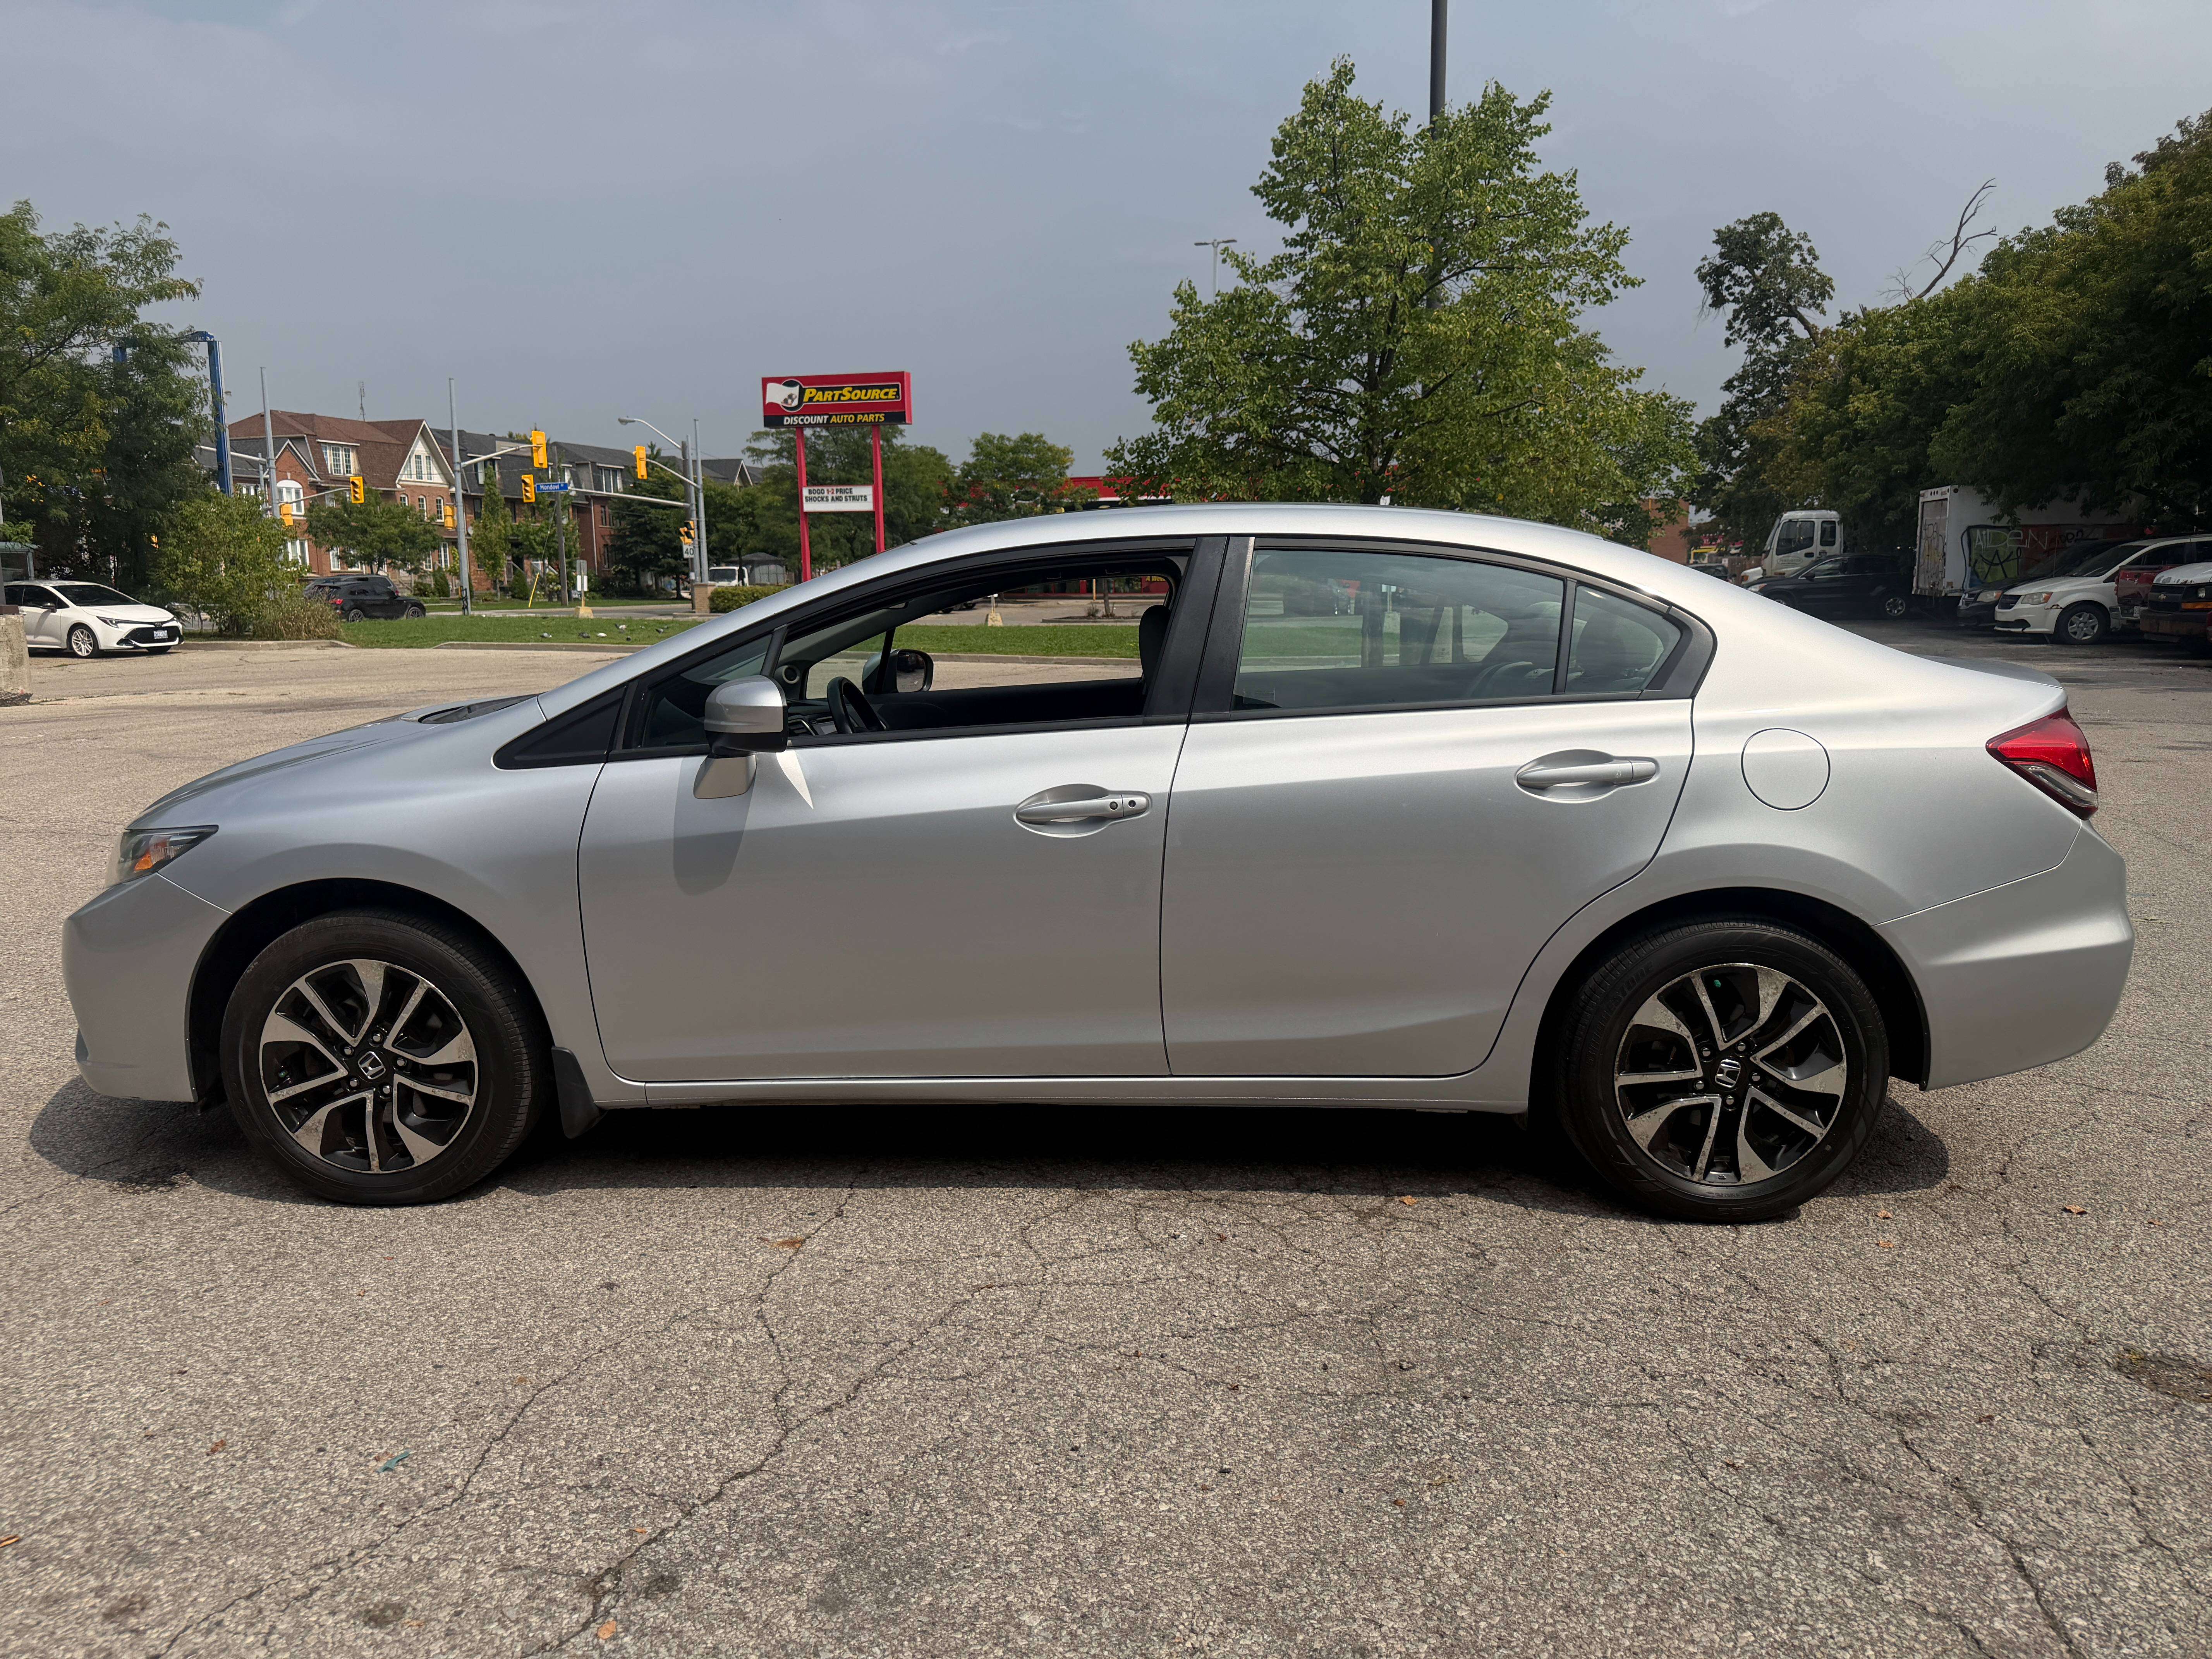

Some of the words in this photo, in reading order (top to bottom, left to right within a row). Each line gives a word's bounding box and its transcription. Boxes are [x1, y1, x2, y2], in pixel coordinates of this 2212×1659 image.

[783, 416, 829, 425] DISCOUNT
[830, 414, 855, 423] AUTO
[857, 413, 885, 422] PARTS
[684, 548, 694, 556] 40
